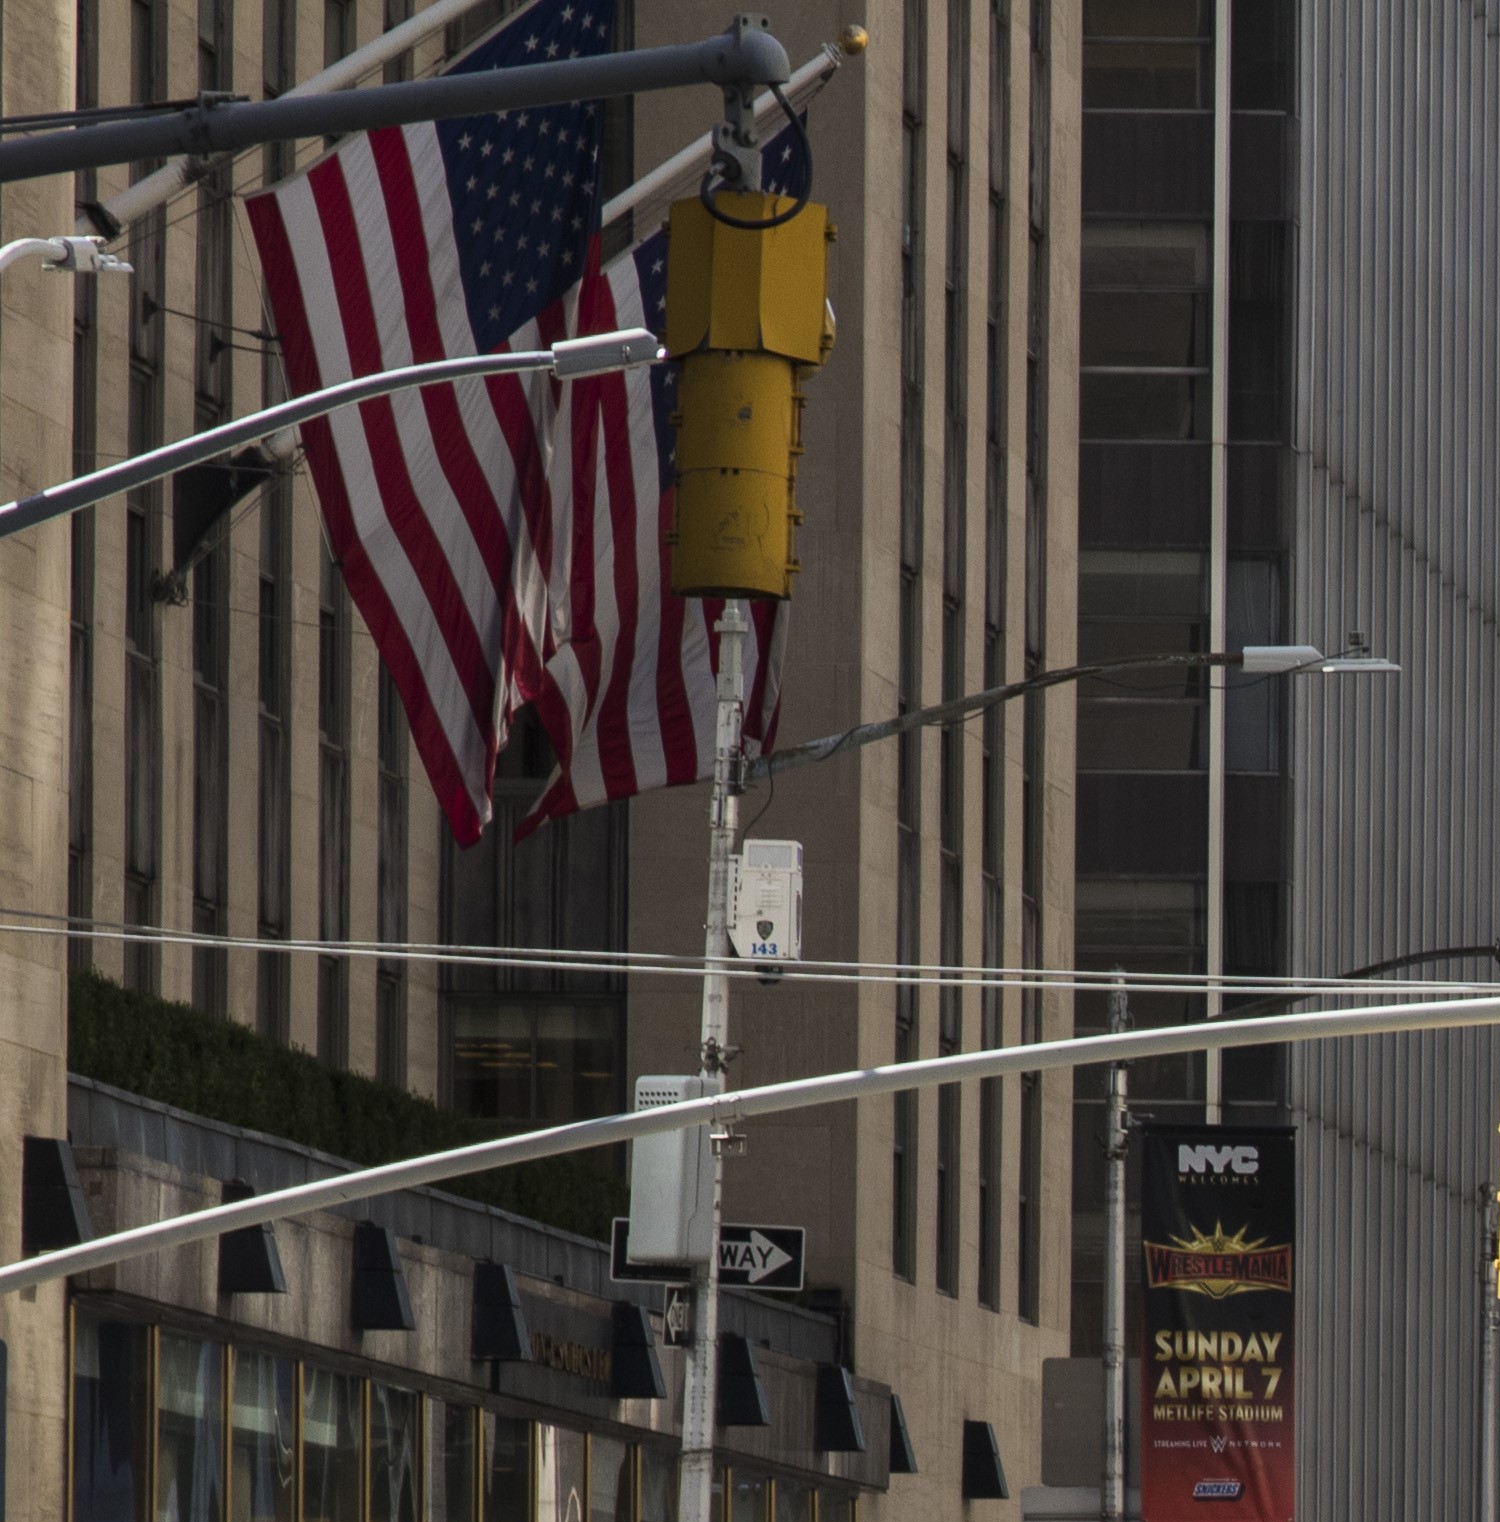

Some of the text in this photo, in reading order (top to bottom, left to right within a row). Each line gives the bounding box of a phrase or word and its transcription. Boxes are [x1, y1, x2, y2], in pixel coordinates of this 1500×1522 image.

[751, 943, 777, 955] 143
[1178, 1144, 1259, 1174] NYC
[1178, 1175, 1259, 1185] WELCOMES
[720, 1245, 774, 1269] WAY
[1155, 1330, 1283, 1362] SUNDAY
[1154, 1366, 1283, 1400] APRIL 7
[1153, 1405, 1283, 1422] METLIFE STADIUM
